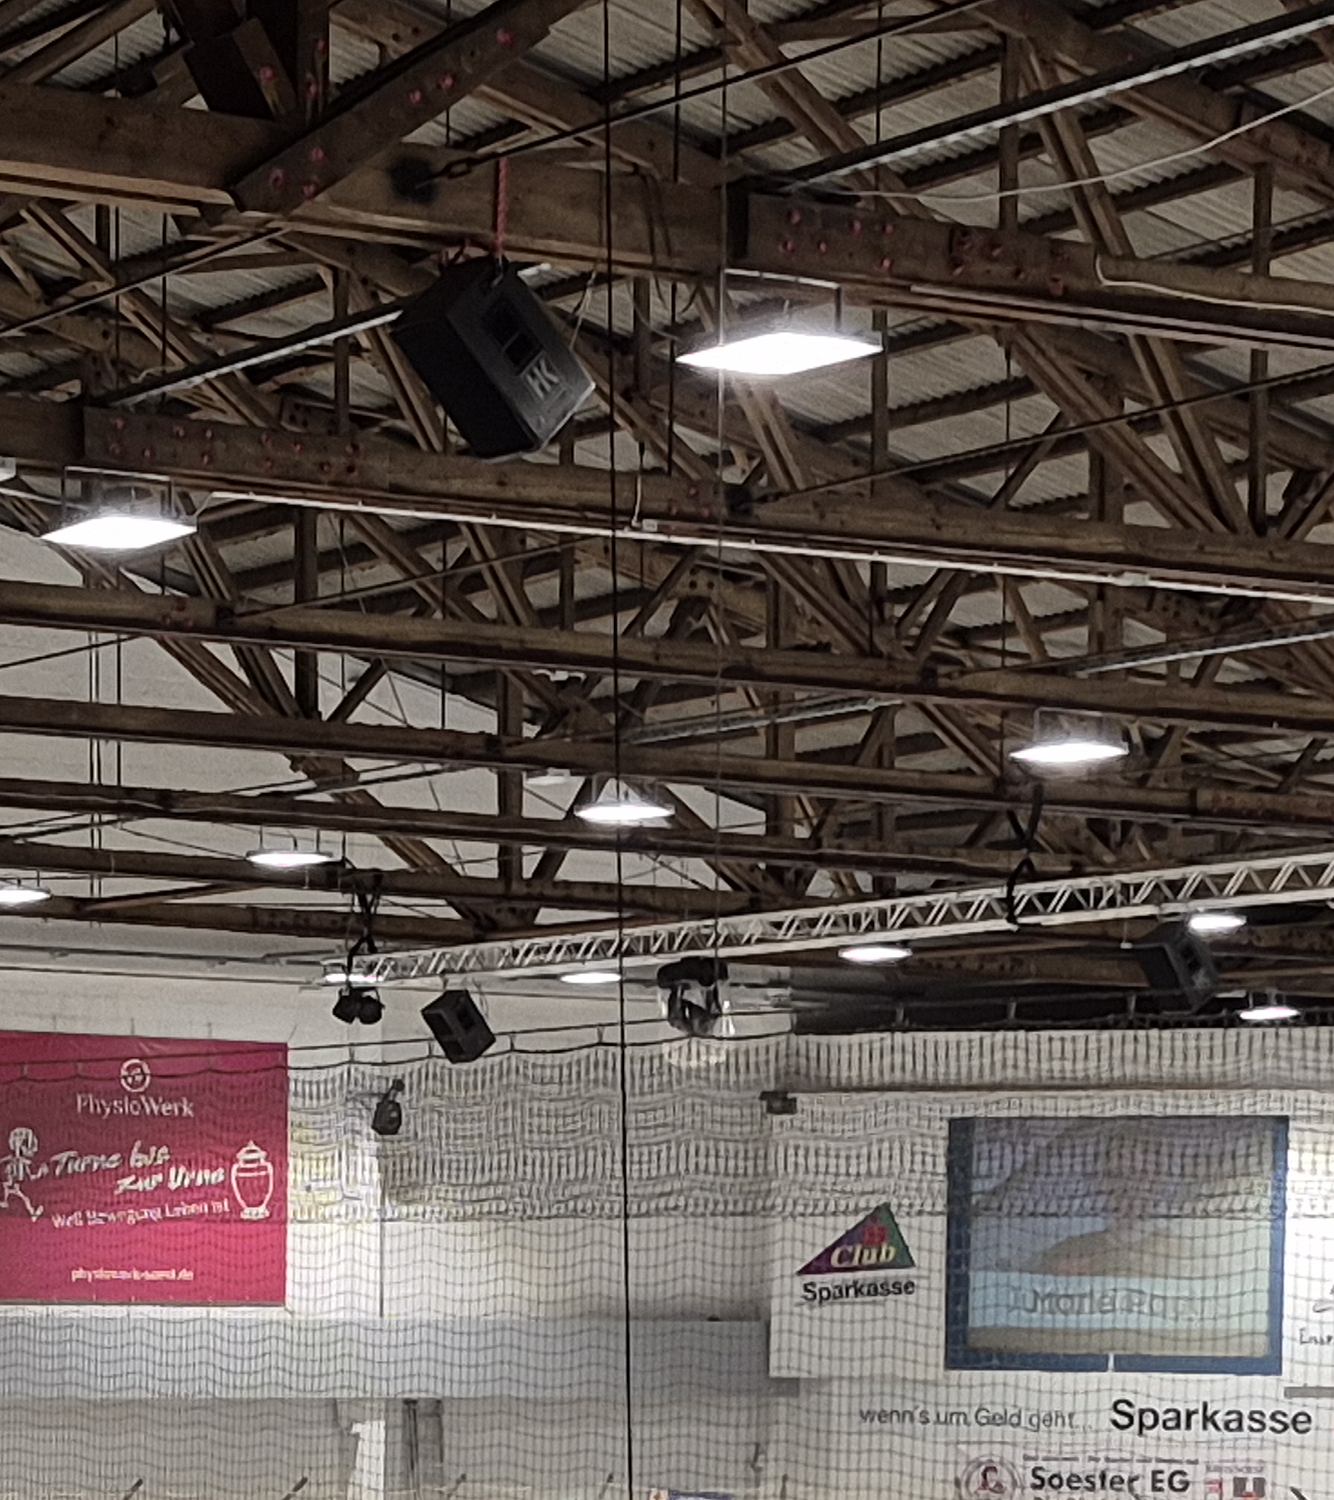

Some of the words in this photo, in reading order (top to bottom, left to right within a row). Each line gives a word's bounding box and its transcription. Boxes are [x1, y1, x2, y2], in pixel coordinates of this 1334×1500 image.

[76, 1092, 195, 1119] PhysioWerk
[51, 1150, 123, 1176] Turne
[830, 1243, 897, 1268] Club
[802, 1281, 916, 1305] Sparkasse
[934, 1411, 969, 1427] um
[974, 1407, 1022, 1429] Geld
[1109, 1399, 1313, 1436] Sparkasse
[1030, 1466, 1139, 1493] Soester
[1150, 1470, 1191, 1494] EG
